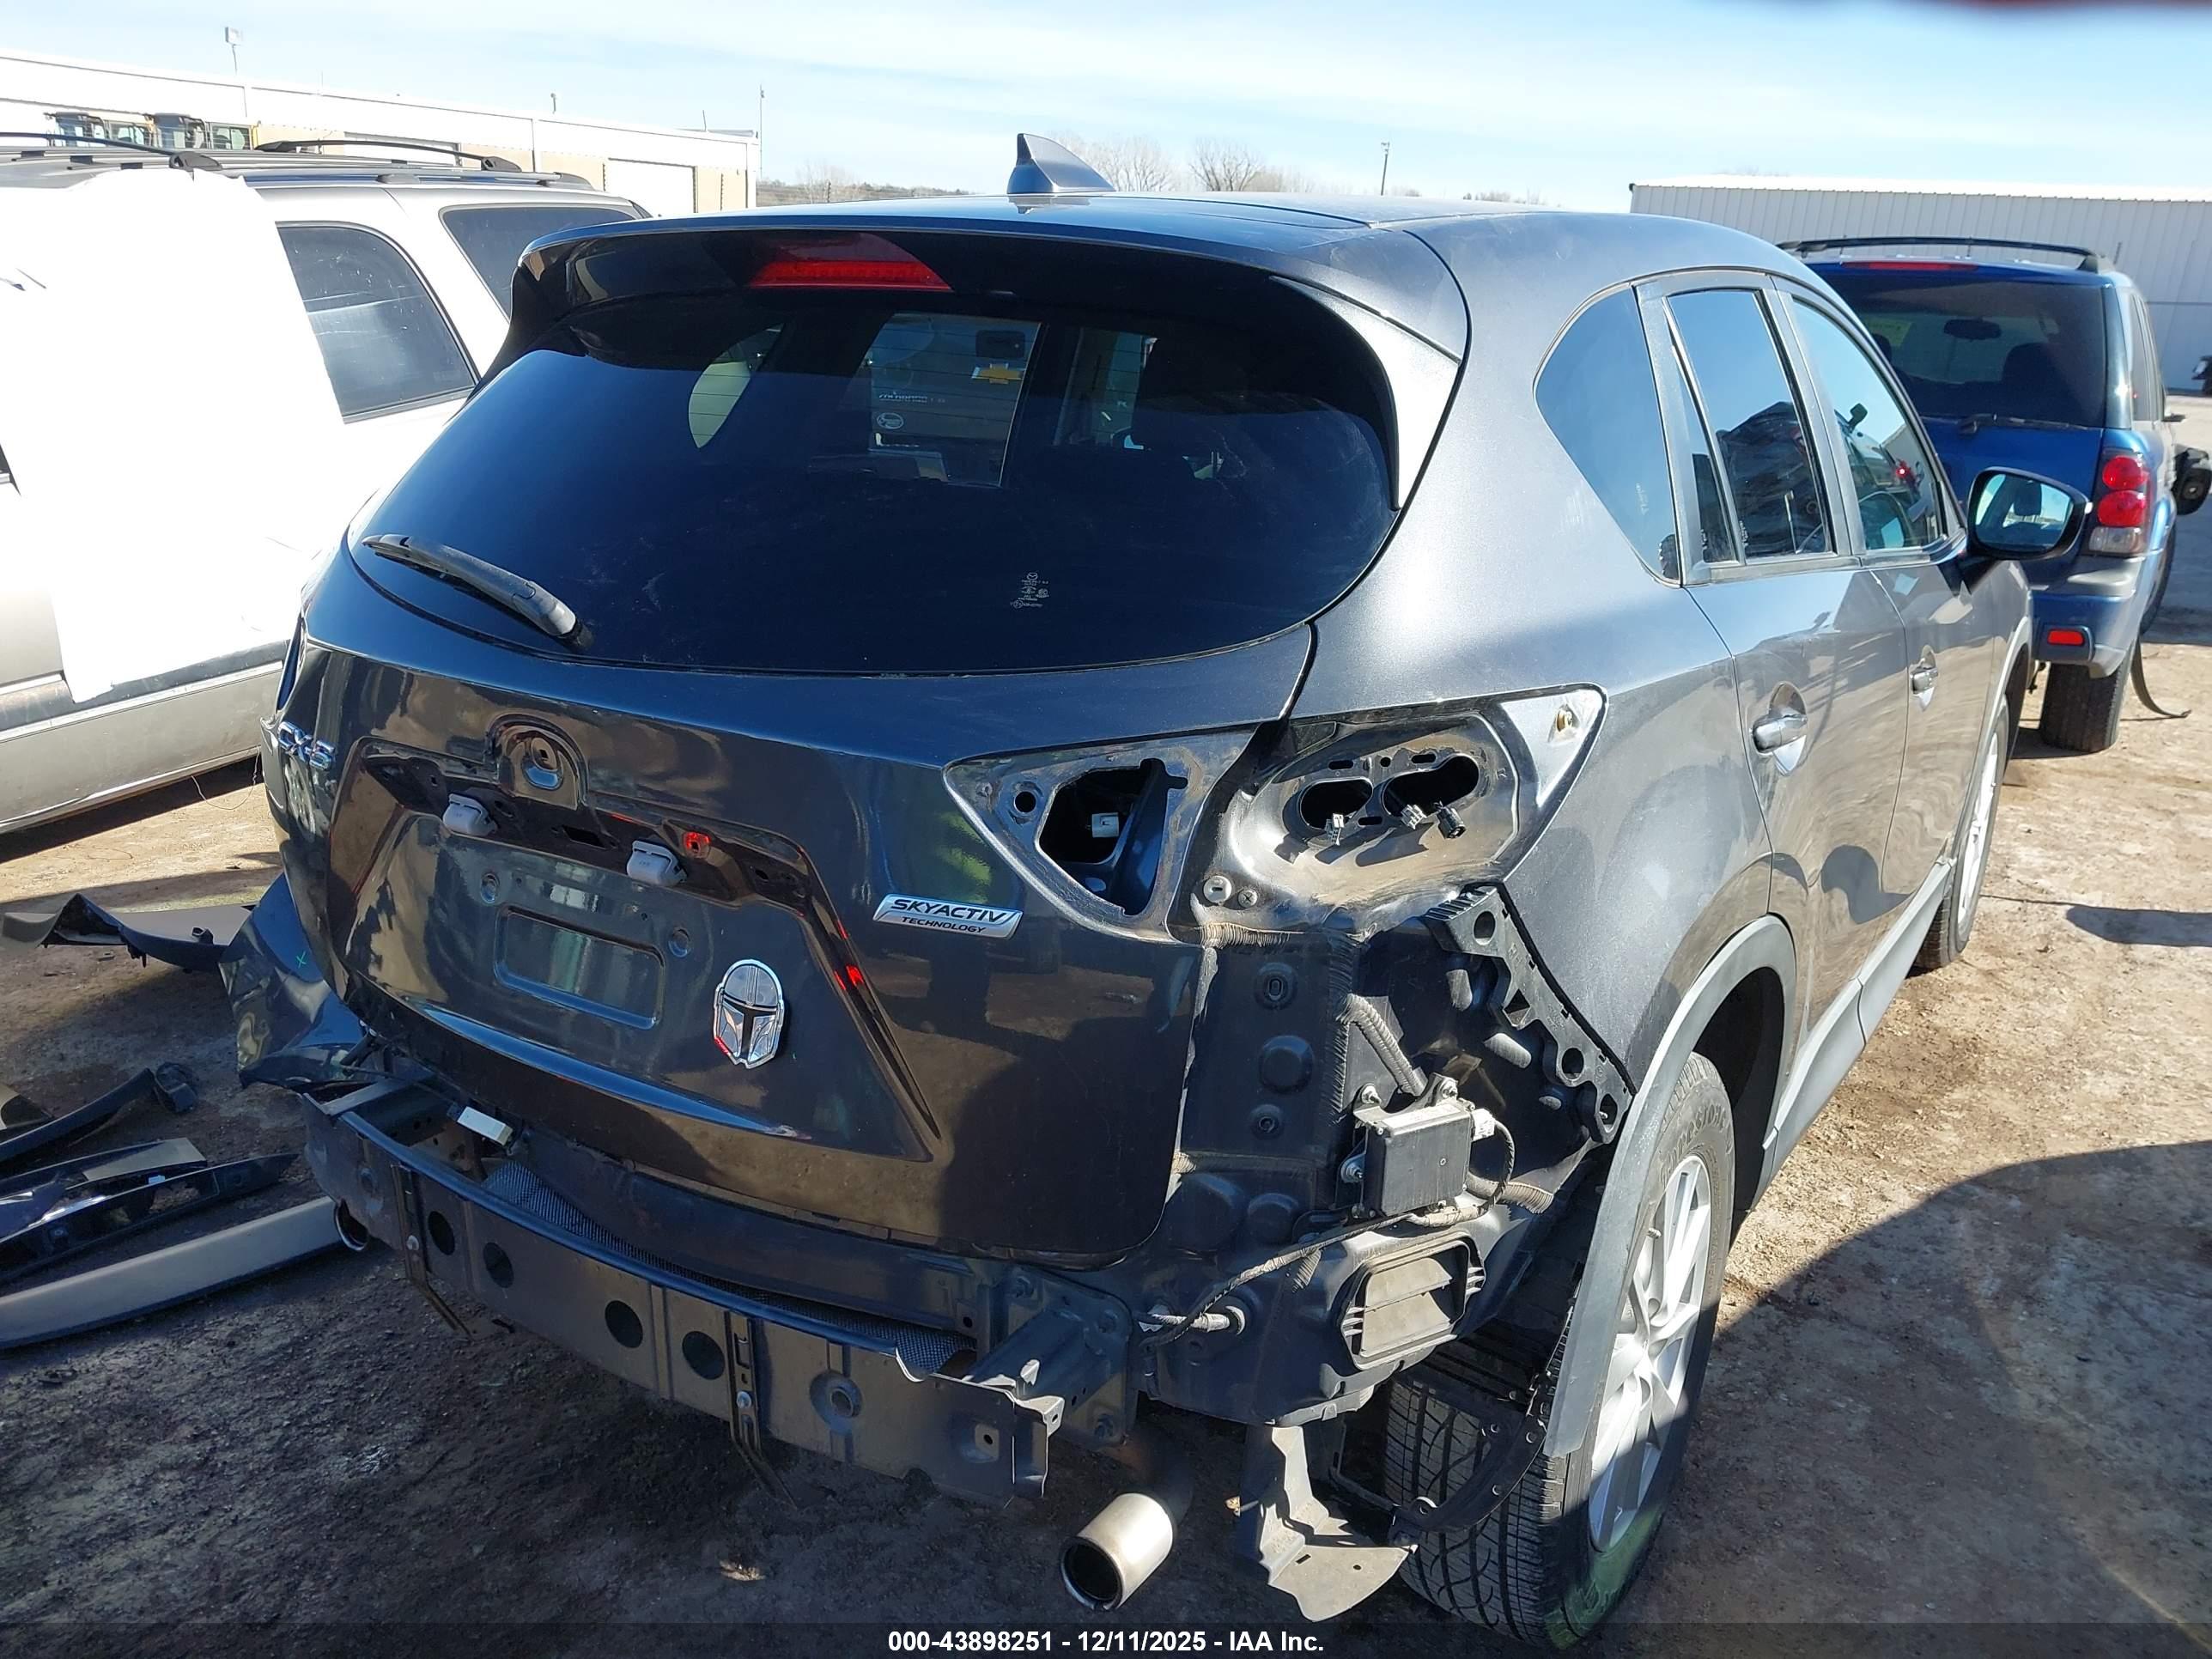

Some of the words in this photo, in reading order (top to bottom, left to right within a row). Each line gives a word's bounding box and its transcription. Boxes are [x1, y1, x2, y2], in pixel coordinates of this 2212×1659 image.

[278, 721, 336, 770] CX-5
[891, 898, 1007, 923] SKYACTIV
[901, 916, 987, 933] TECHNOLOGY
